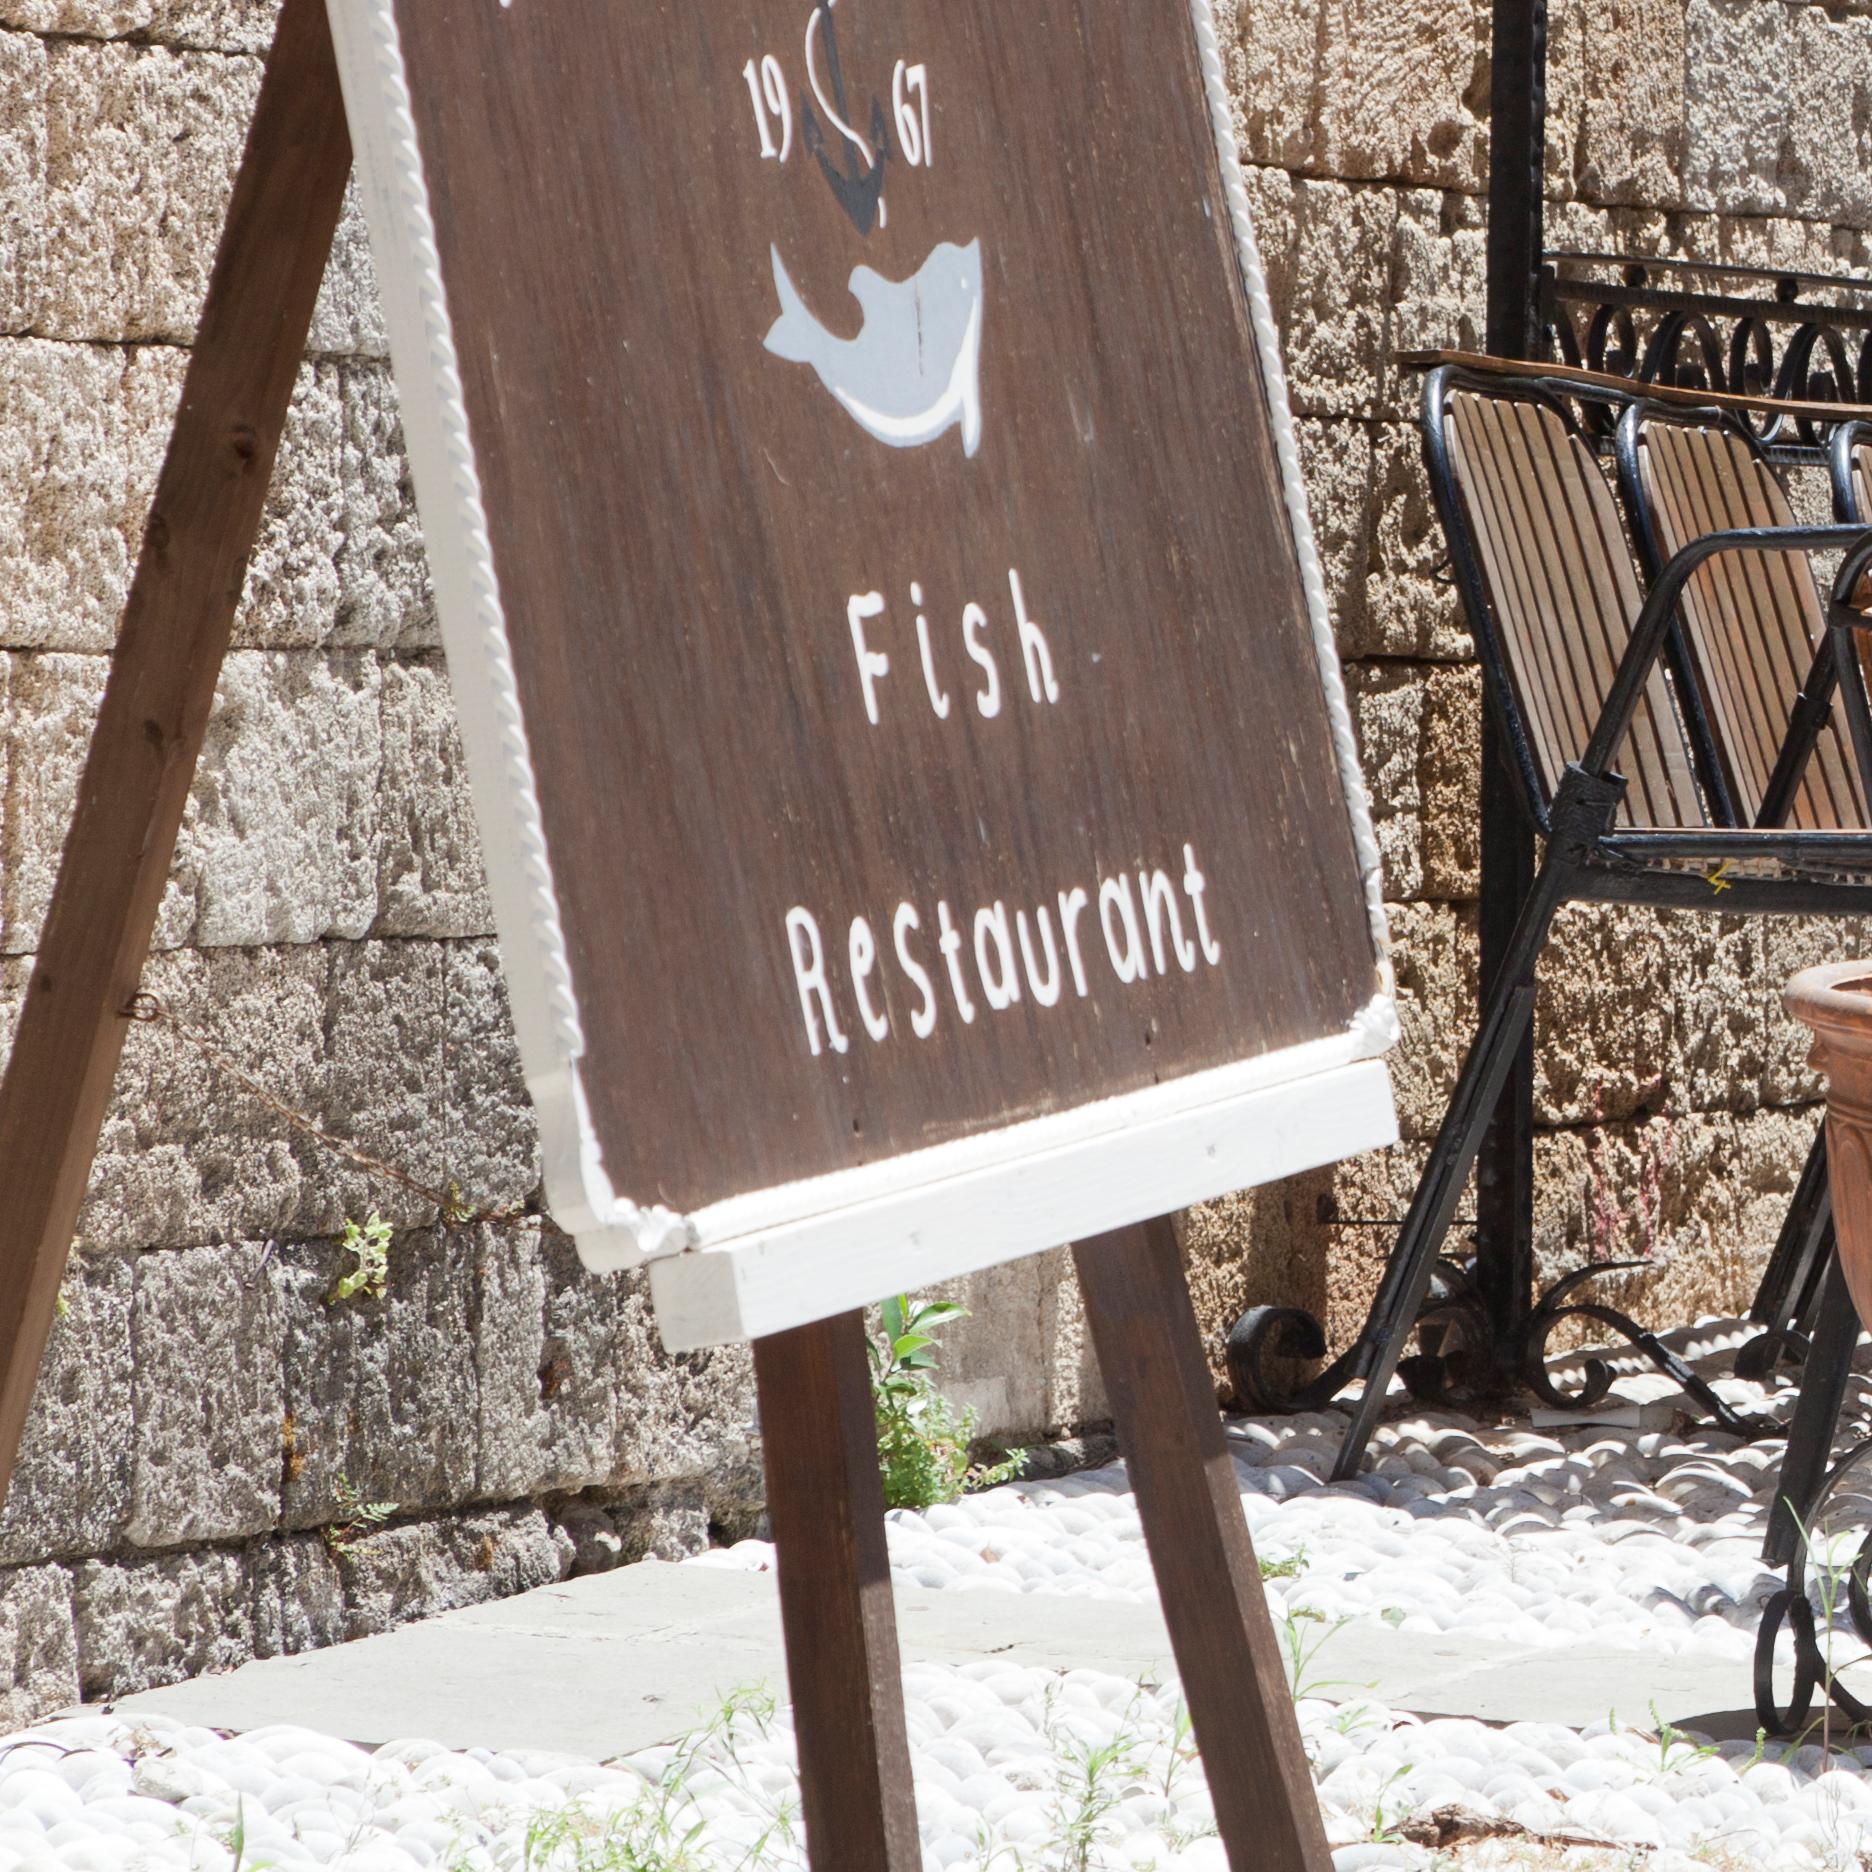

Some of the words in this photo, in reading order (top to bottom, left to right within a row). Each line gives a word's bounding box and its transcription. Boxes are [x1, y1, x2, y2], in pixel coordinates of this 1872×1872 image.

[742, 53, 793, 164] 19
[892, 58, 932, 168] 67
[847, 567, 1059, 726] Fish
[785, 842, 1221, 1057] Restaurant
